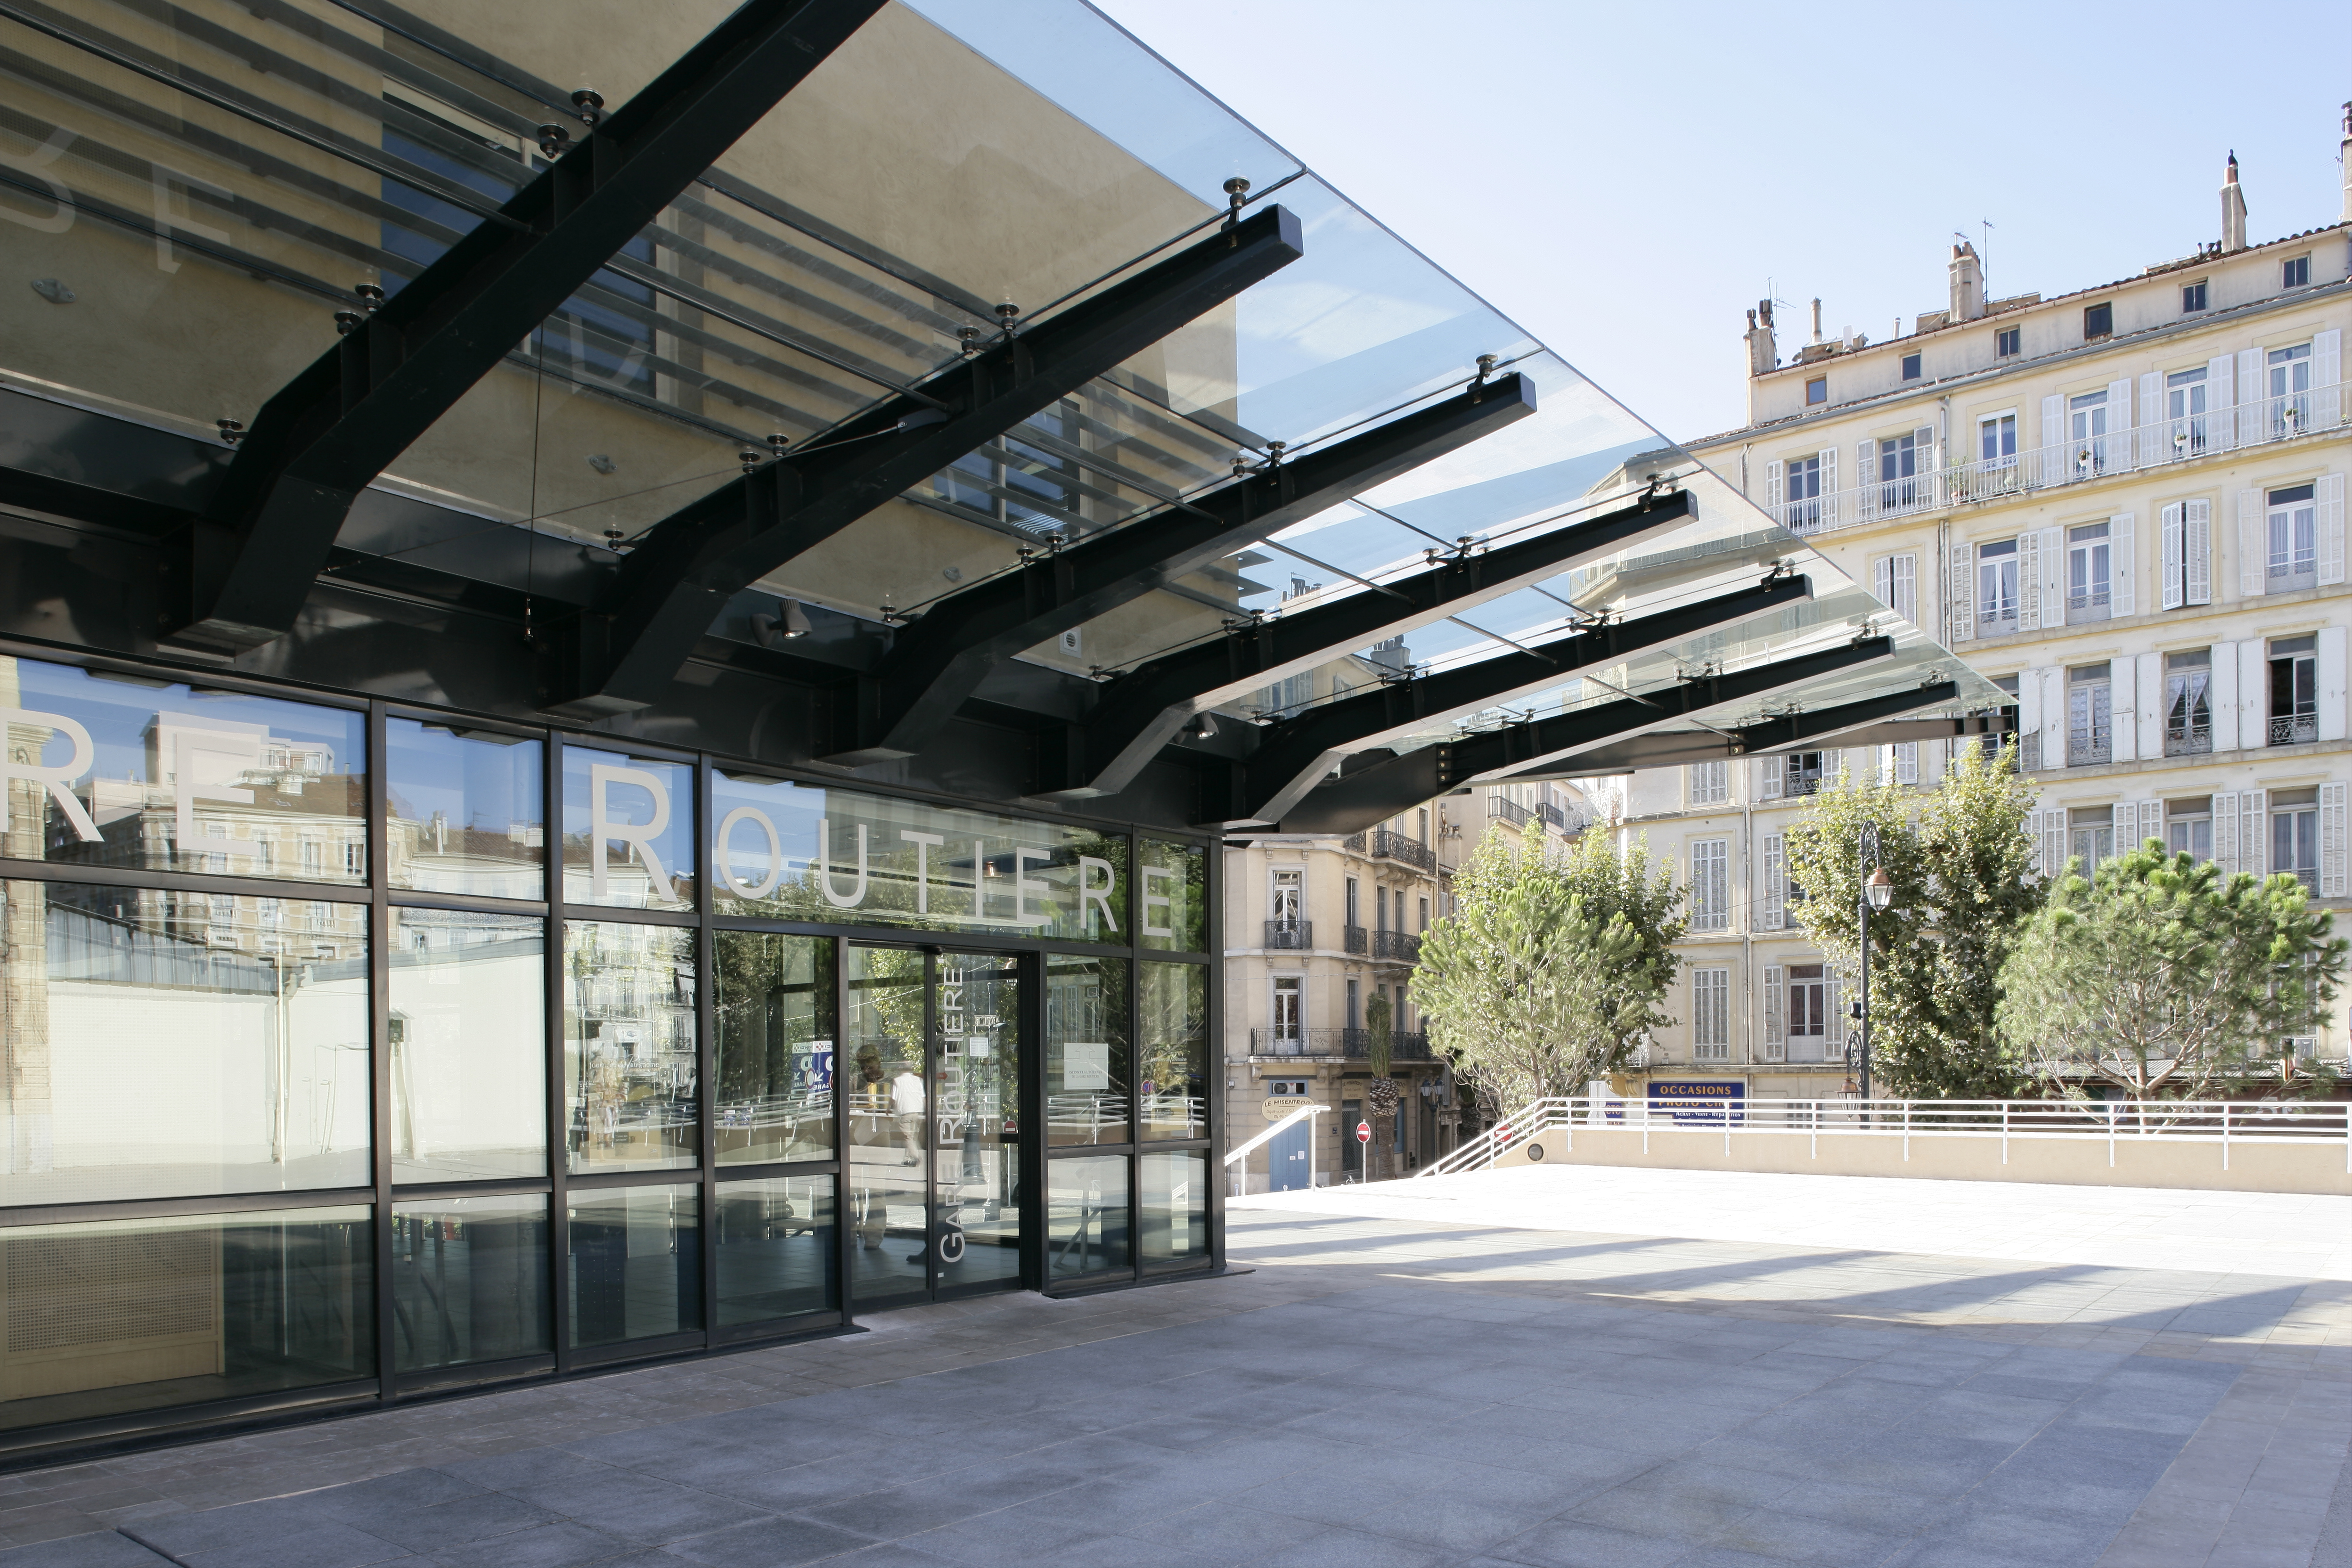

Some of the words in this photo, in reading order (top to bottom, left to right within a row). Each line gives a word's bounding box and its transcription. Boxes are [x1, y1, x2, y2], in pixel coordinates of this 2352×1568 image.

[592, 763, 1172, 937] ROUTIERE
[939, 967, 964, 1144] ROUTIERE
[1660, 1086, 1731, 1094] OCCASIONS
[940, 1162, 965, 1263] GARE
